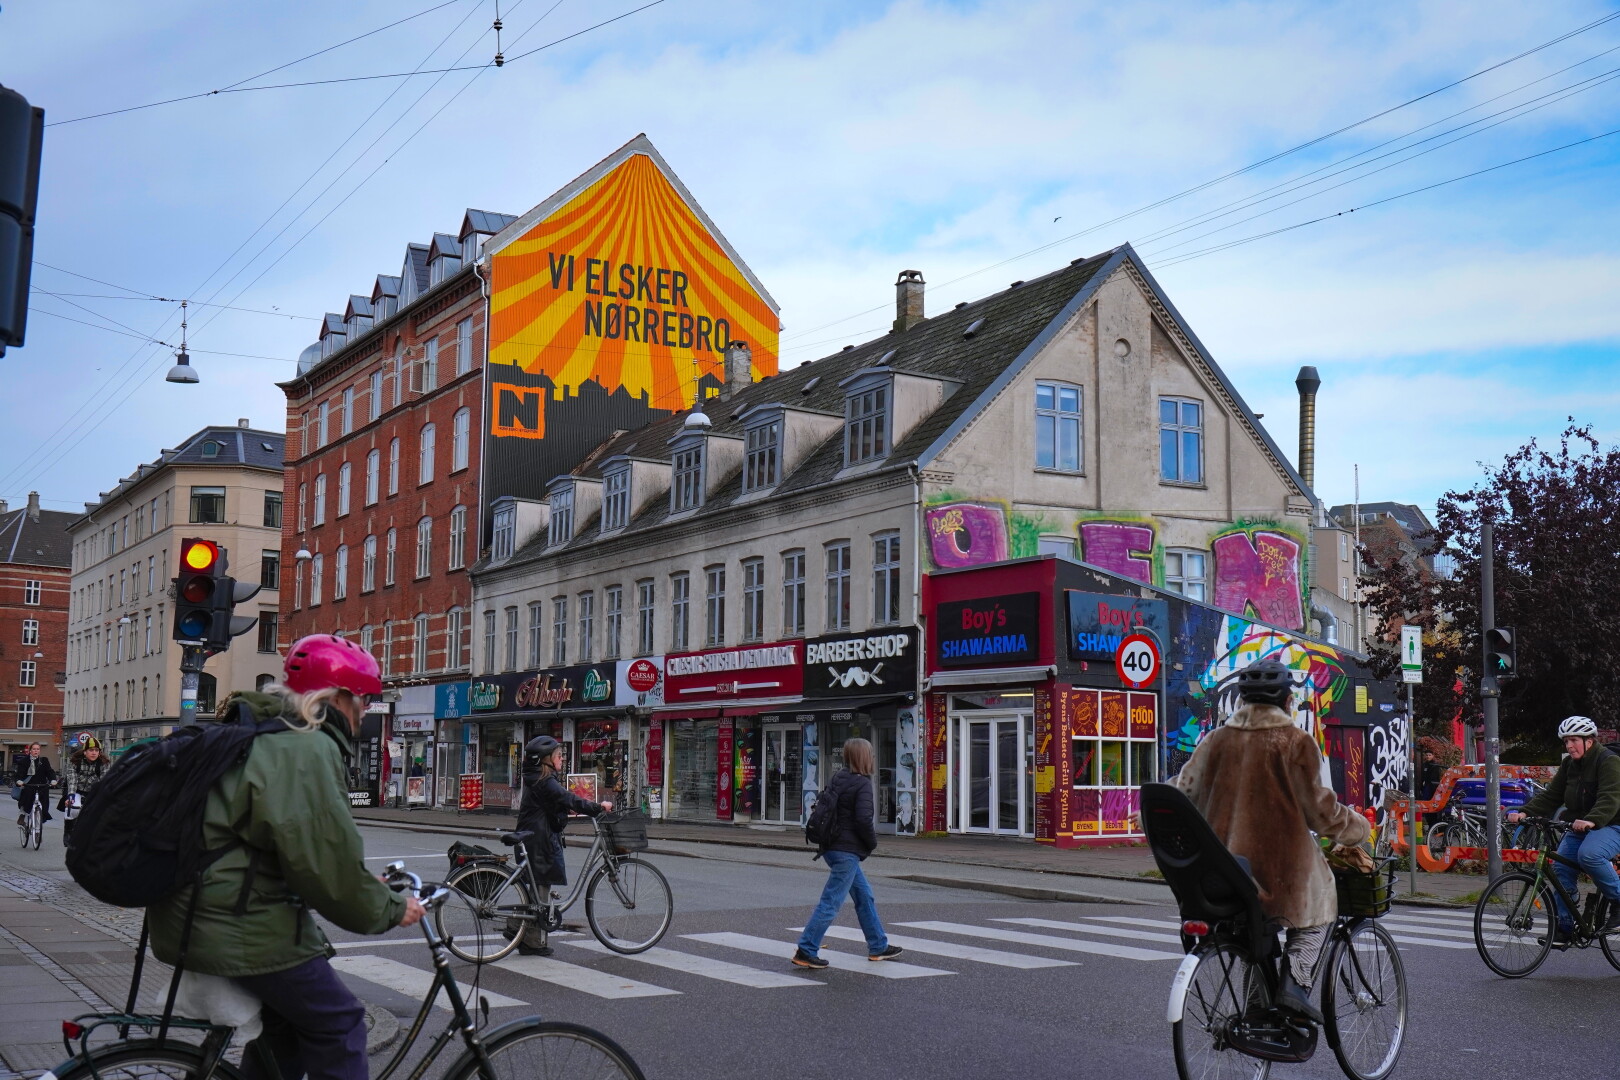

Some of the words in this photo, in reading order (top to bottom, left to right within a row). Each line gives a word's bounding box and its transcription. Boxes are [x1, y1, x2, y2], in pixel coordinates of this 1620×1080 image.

[549, 252, 575, 292] VI
[586, 257, 689, 308] ELSKER
[584, 300, 731, 354] NØRREBRO
[499, 389, 540, 430] N
[962, 603, 1007, 634] Boy's
[1097, 601, 1145, 633] Boy's
[806, 639, 866, 665] BARBER
[866, 634, 909, 660] SHOP
[942, 633, 1029, 658] SHAWARMA
[630, 672, 655, 680] CAESAR
[1123, 651, 1151, 672] 40
[583, 670, 608, 700] Pizza
[1060, 691, 1068, 723] Byens
[1131, 708, 1154, 725] FOOD
[1061, 760, 1069, 786] Grill
[347, 791, 370, 799] WEED
[1060, 789, 1069, 829] Kylling
